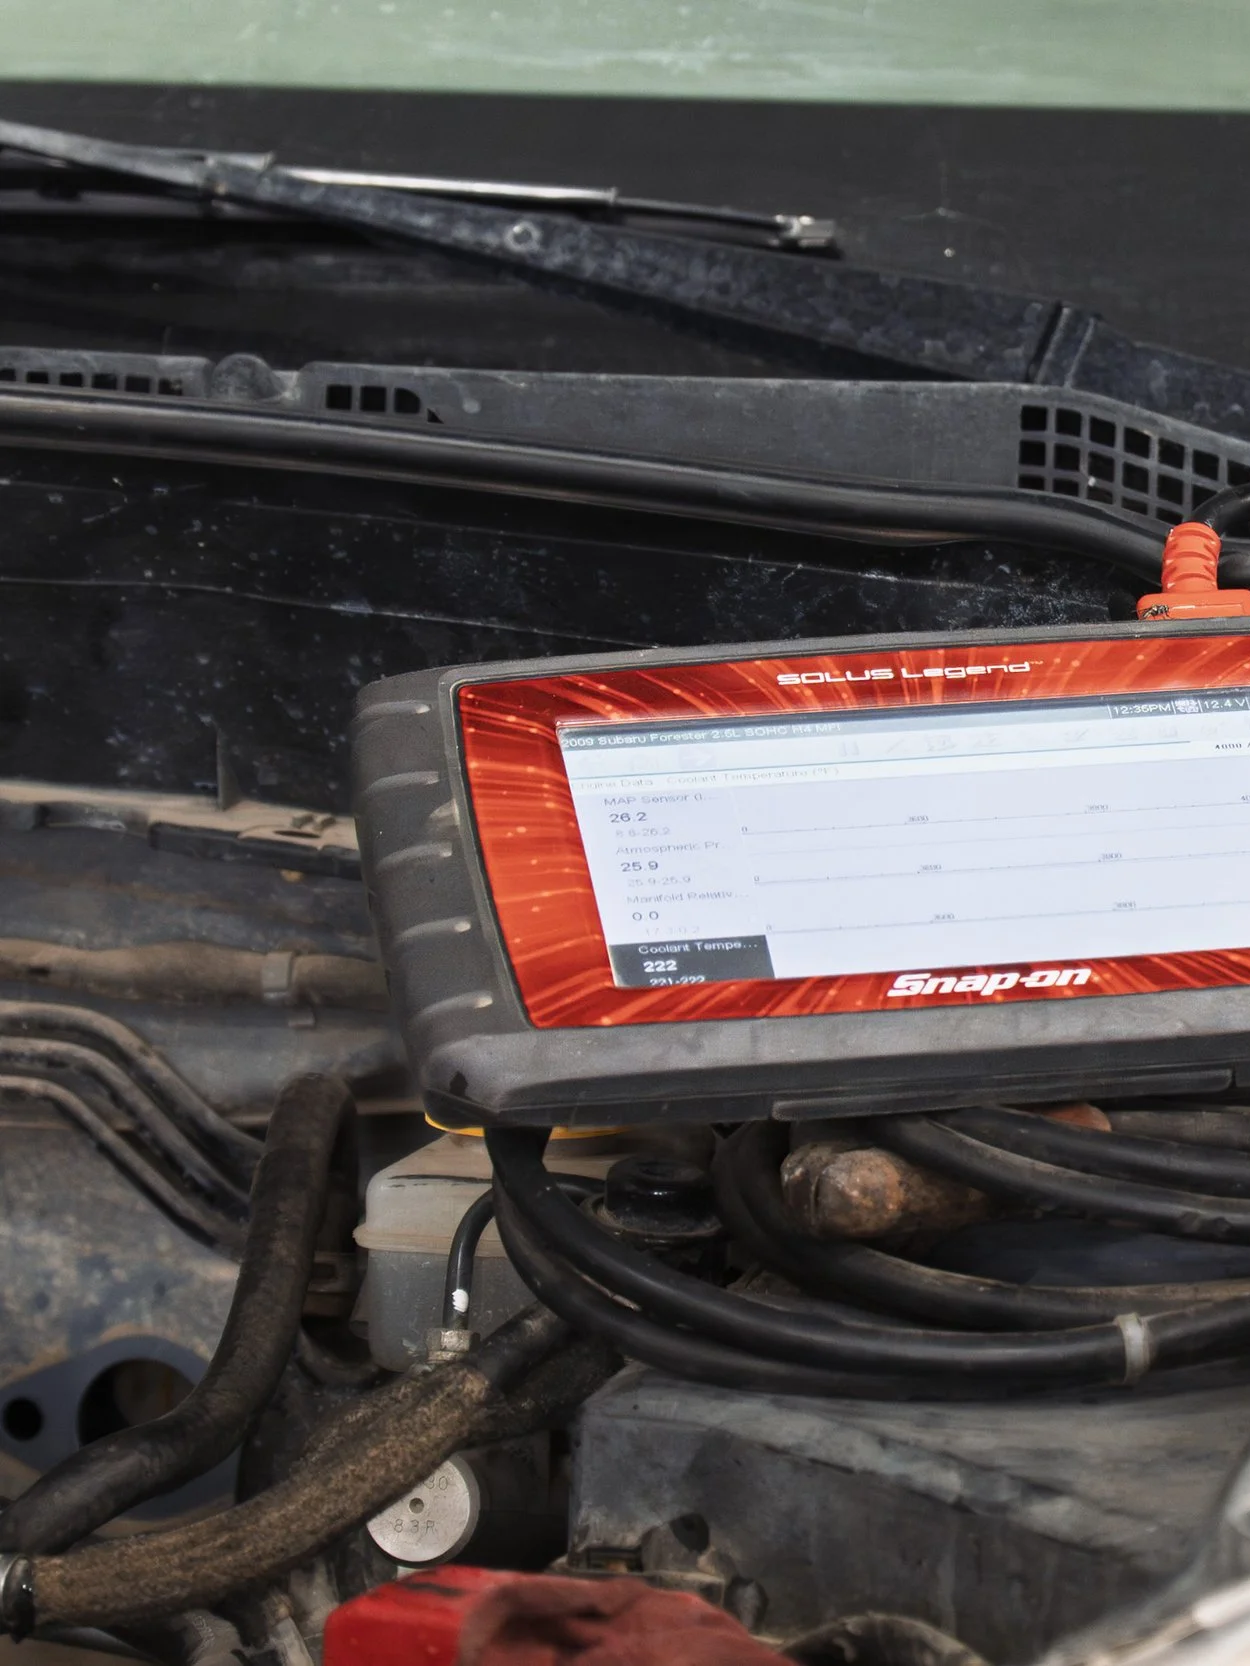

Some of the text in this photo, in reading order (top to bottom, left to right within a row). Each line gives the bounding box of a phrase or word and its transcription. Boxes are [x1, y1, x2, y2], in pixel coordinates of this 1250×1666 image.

[777, 661, 1031, 685] SOLUS Legend
[1203, 698, 1247, 710] 12.4 V
[562, 737, 595, 749] 2009
[598, 734, 647, 746] Subaru
[650, 731, 706, 744] Forester
[620, 777, 654, 787] Data
[666, 773, 718, 785] Coolant
[722, 768, 809, 782] Temperature
[603, 796, 638, 807] MAP
[641, 793, 689, 804] Sensor
[608, 811, 648, 824] 26.2
[616, 842, 700, 855] Atmospheric
[620, 860, 660, 873] 25.9
[626, 892, 684, 904] Manifold
[638, 944, 691, 955] Coolant
[643, 960, 678, 972] 222
[886, 968, 1092, 996] Snap-on
